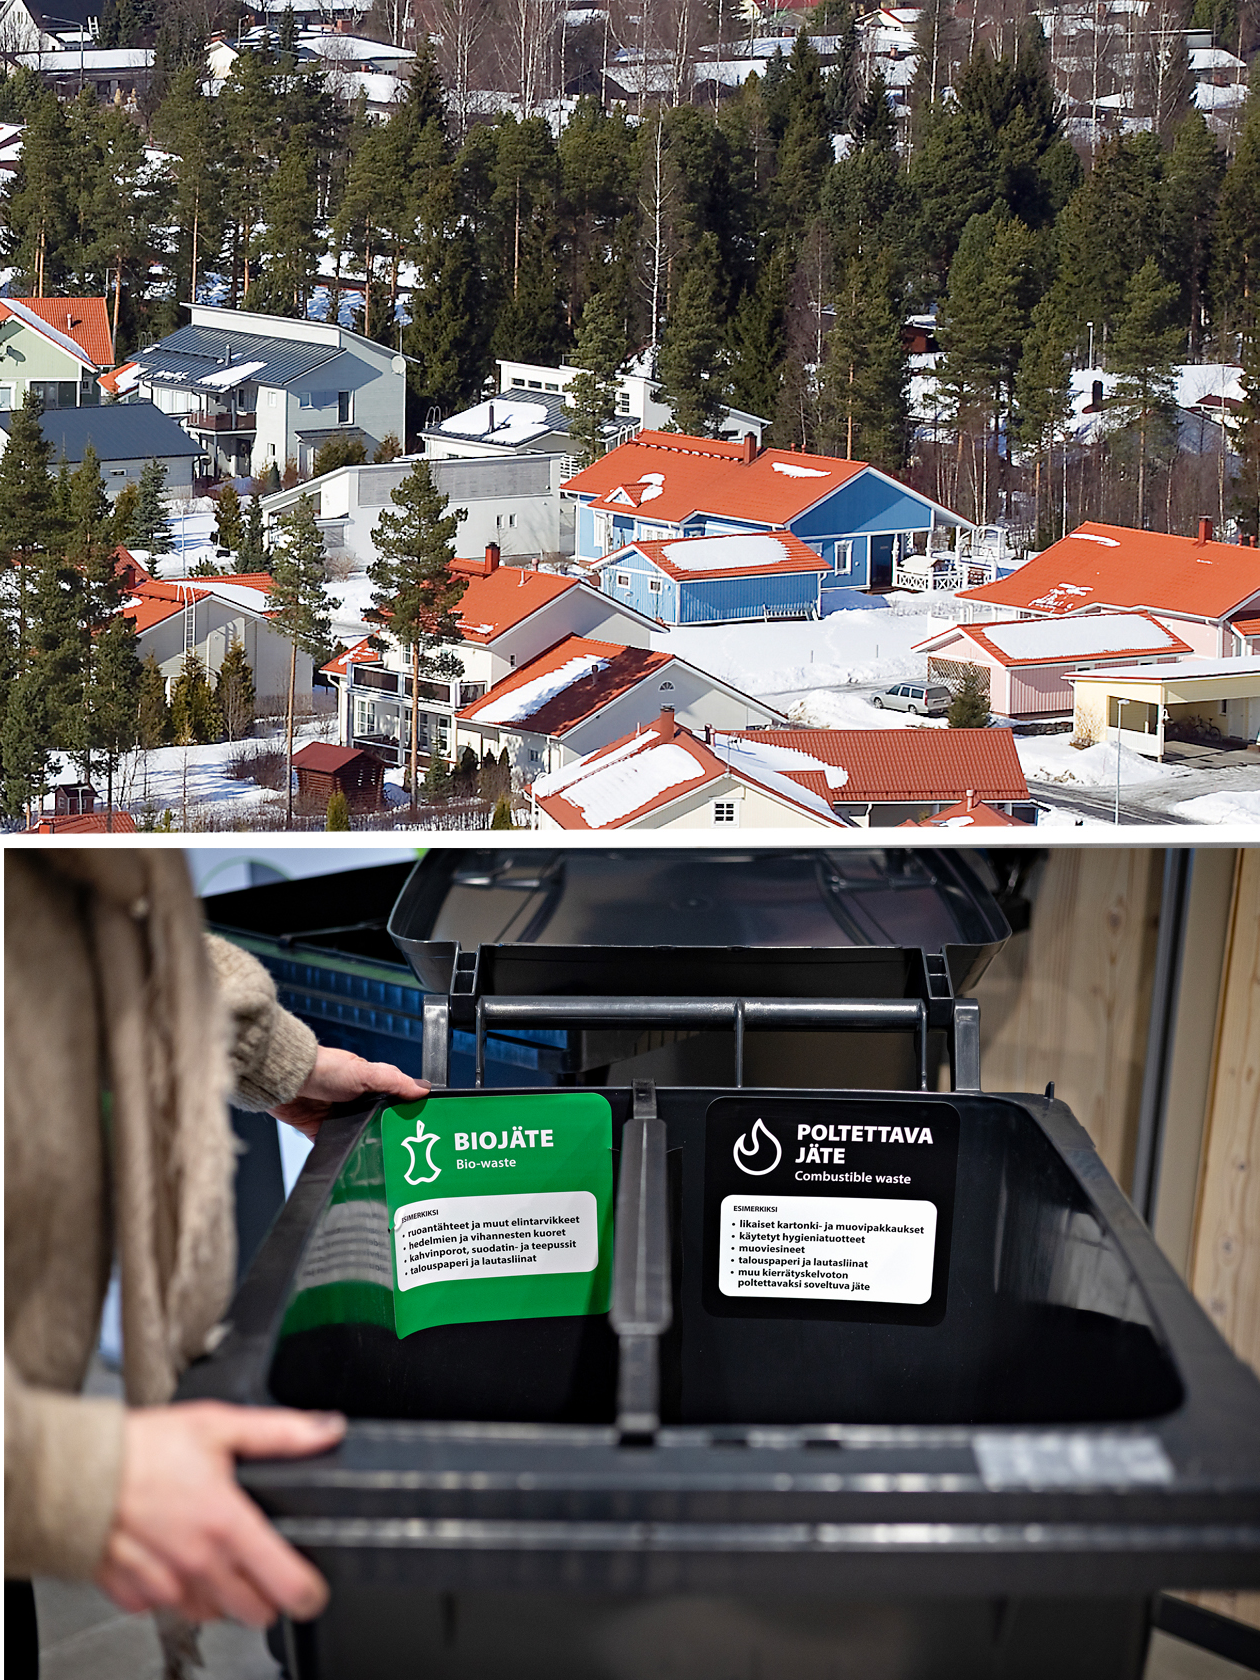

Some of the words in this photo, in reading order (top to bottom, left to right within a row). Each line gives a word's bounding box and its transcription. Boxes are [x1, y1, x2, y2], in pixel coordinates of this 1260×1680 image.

[454, 1126, 554, 1151] BIOJÄTE
[797, 1124, 934, 1144] POLTETTAVA
[795, 1143, 845, 1164] JÄTE
[456, 1157, 517, 1170] Bio-waste
[794, 1170, 873, 1183] Combustible
[875, 1174, 912, 1184] waste
[733, 1205, 778, 1213] ESIMERKIKSI
[407, 1221, 470, 1237] ruoantähteet
[471, 1220, 481, 1231] ja
[482, 1219, 509, 1228] muut
[511, 1216, 580, 1227] elintarvikkeet
[739, 1219, 775, 1229] likaiset
[777, 1220, 822, 1230] kartonki-
[823, 1222, 834, 1232] ja
[835, 1223, 924, 1234] muovipakkaukset
[408, 1236, 457, 1250] hedelmien
[459, 1234, 469, 1244] ja
[470, 1231, 531, 1241] vihannesten
[533, 1228, 566, 1238] kuoret
[739, 1231, 780, 1242] käytetyt
[782, 1233, 866, 1243] hygieniatuotteet
[409, 1246, 469, 1262] kahvinporot,
[471, 1243, 518, 1254] suodatin-
[520, 1242, 530, 1252] ja
[531, 1240, 577, 1251] teepussit
[738, 1245, 806, 1253] muoviesineet
[410, 1258, 469, 1275] talouspaperi
[470, 1257, 480, 1268] ja
[481, 1254, 537, 1265] lautasliinat
[738, 1256, 800, 1267] talouspaperi
[801, 1257, 811, 1267] ja
[813, 1258, 868, 1268] lautasliinat
[762, 1268, 848, 1279] kierrätyskelvoton
[737, 1278, 802, 1288] poltettavaksi
[803, 1280, 850, 1290] soveltuva
[851, 1282, 871, 1292] jäte
